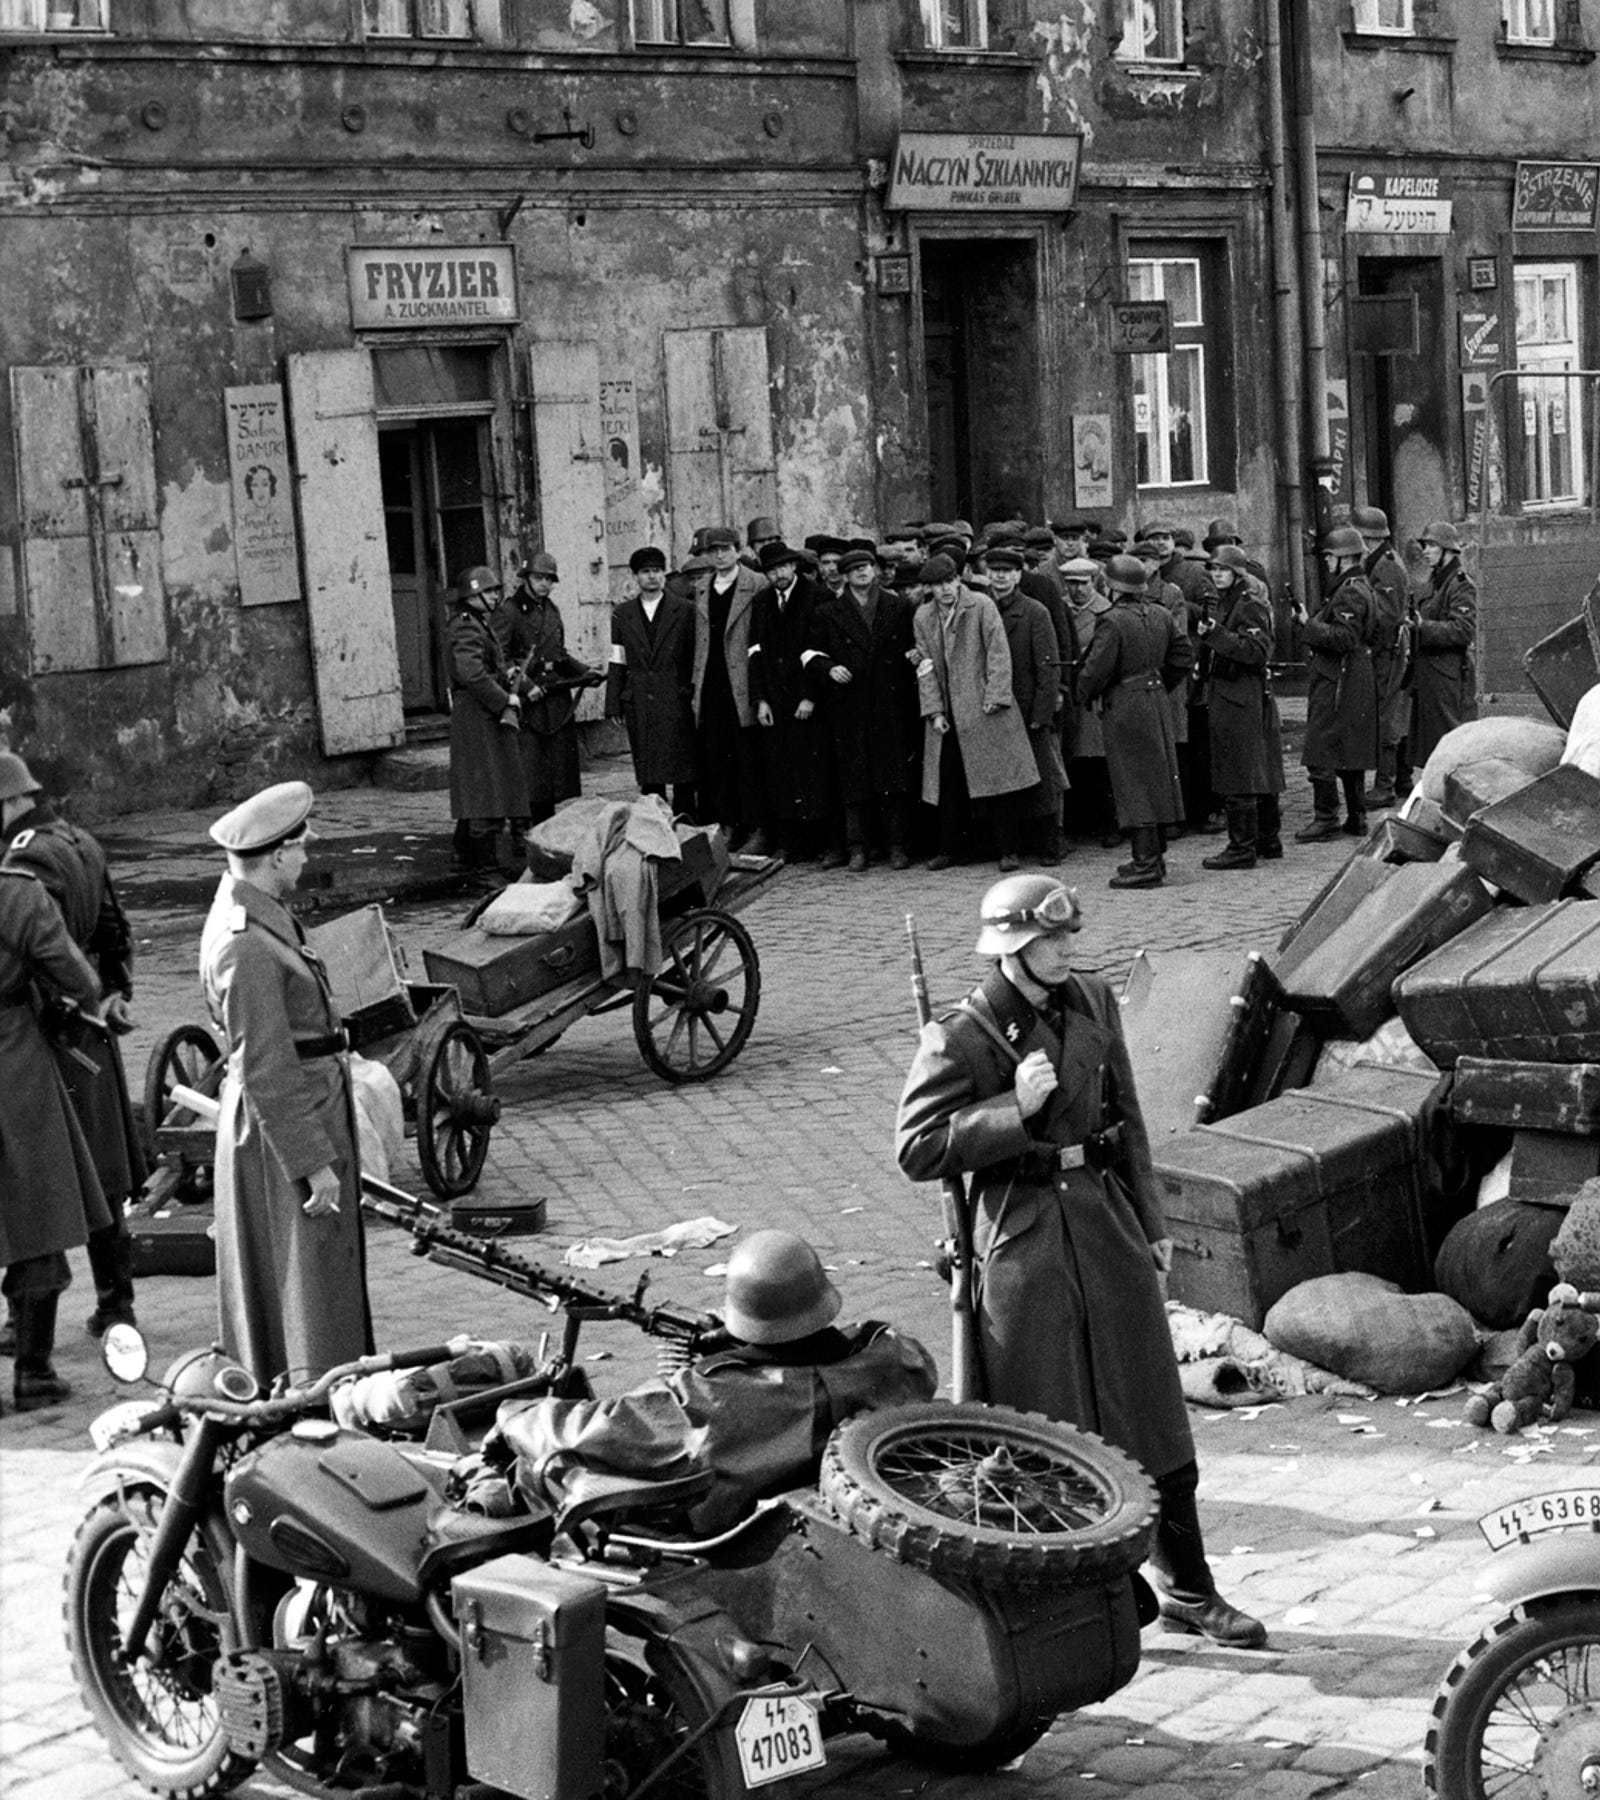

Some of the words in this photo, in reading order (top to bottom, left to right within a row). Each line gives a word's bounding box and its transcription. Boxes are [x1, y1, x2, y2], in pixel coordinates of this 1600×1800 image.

[1519, 167, 1594, 210] OSTRZENIE
[364, 260, 499, 300] FRYZJER
[399, 301, 491, 319] ZUCKMANTEL
[236, 441, 285, 461] DAMSKI
[606, 519, 637, 536] OLENIE
[751, 1723, 813, 1770] 47083
